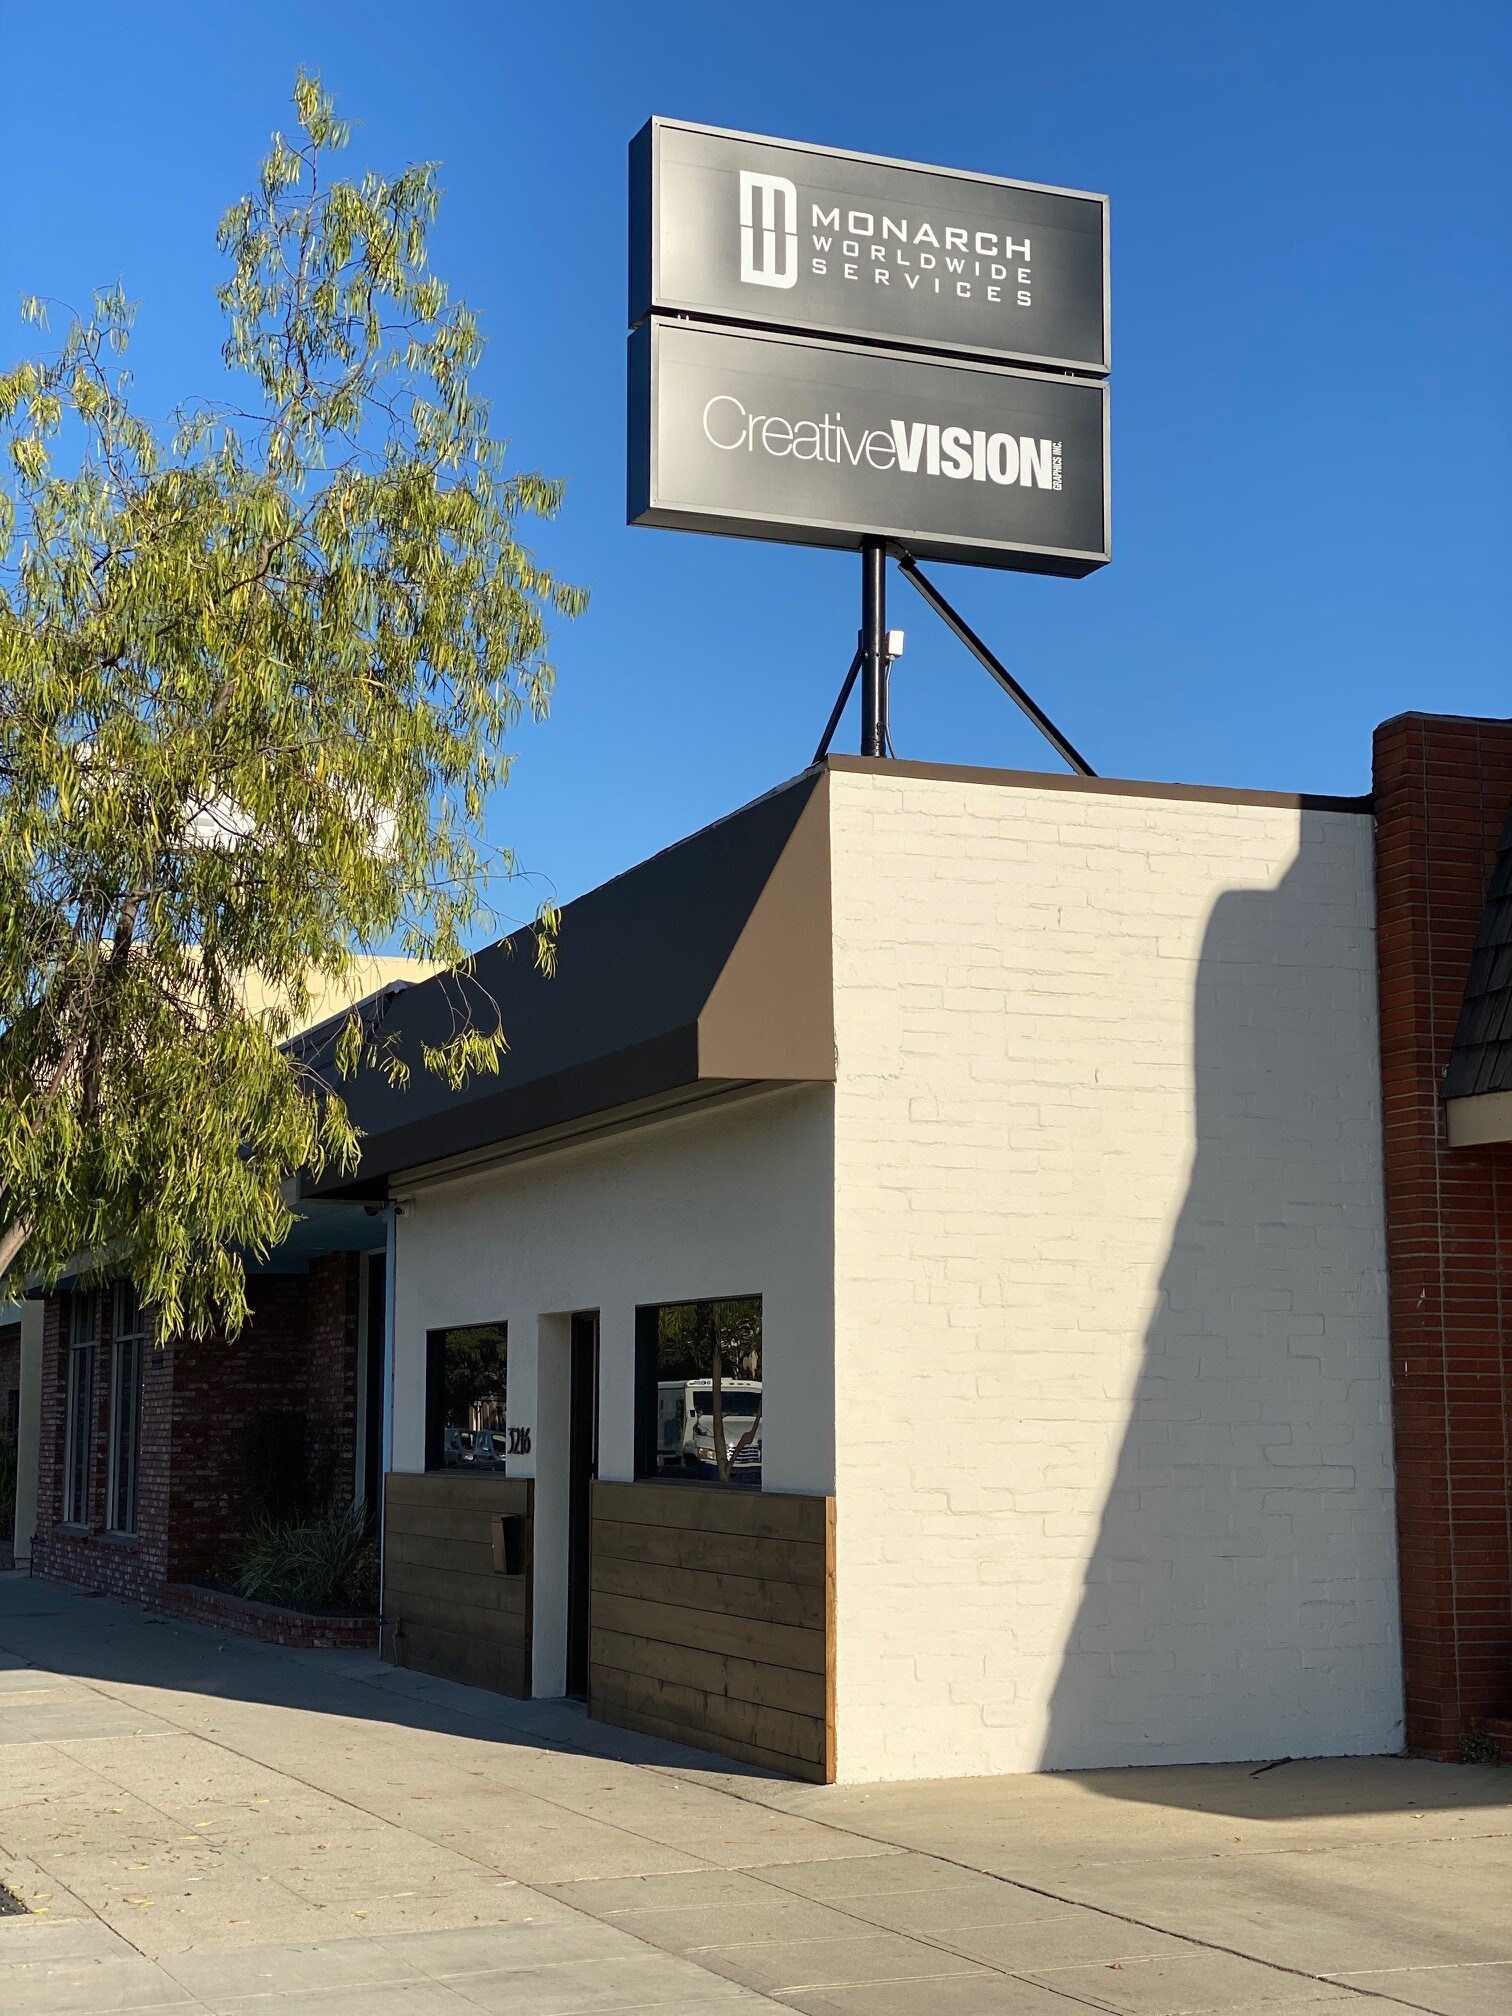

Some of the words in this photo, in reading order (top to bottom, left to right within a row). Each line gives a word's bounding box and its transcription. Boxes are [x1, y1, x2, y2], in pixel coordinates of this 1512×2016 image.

[811, 203, 1031, 262] MONARCH
[811, 258, 1032, 307] SERVICES
[812, 235, 1032, 284] WORLDWIDE
[1052, 441, 1062, 456] INC.
[1052, 456, 1062, 491] GRAPHICS
